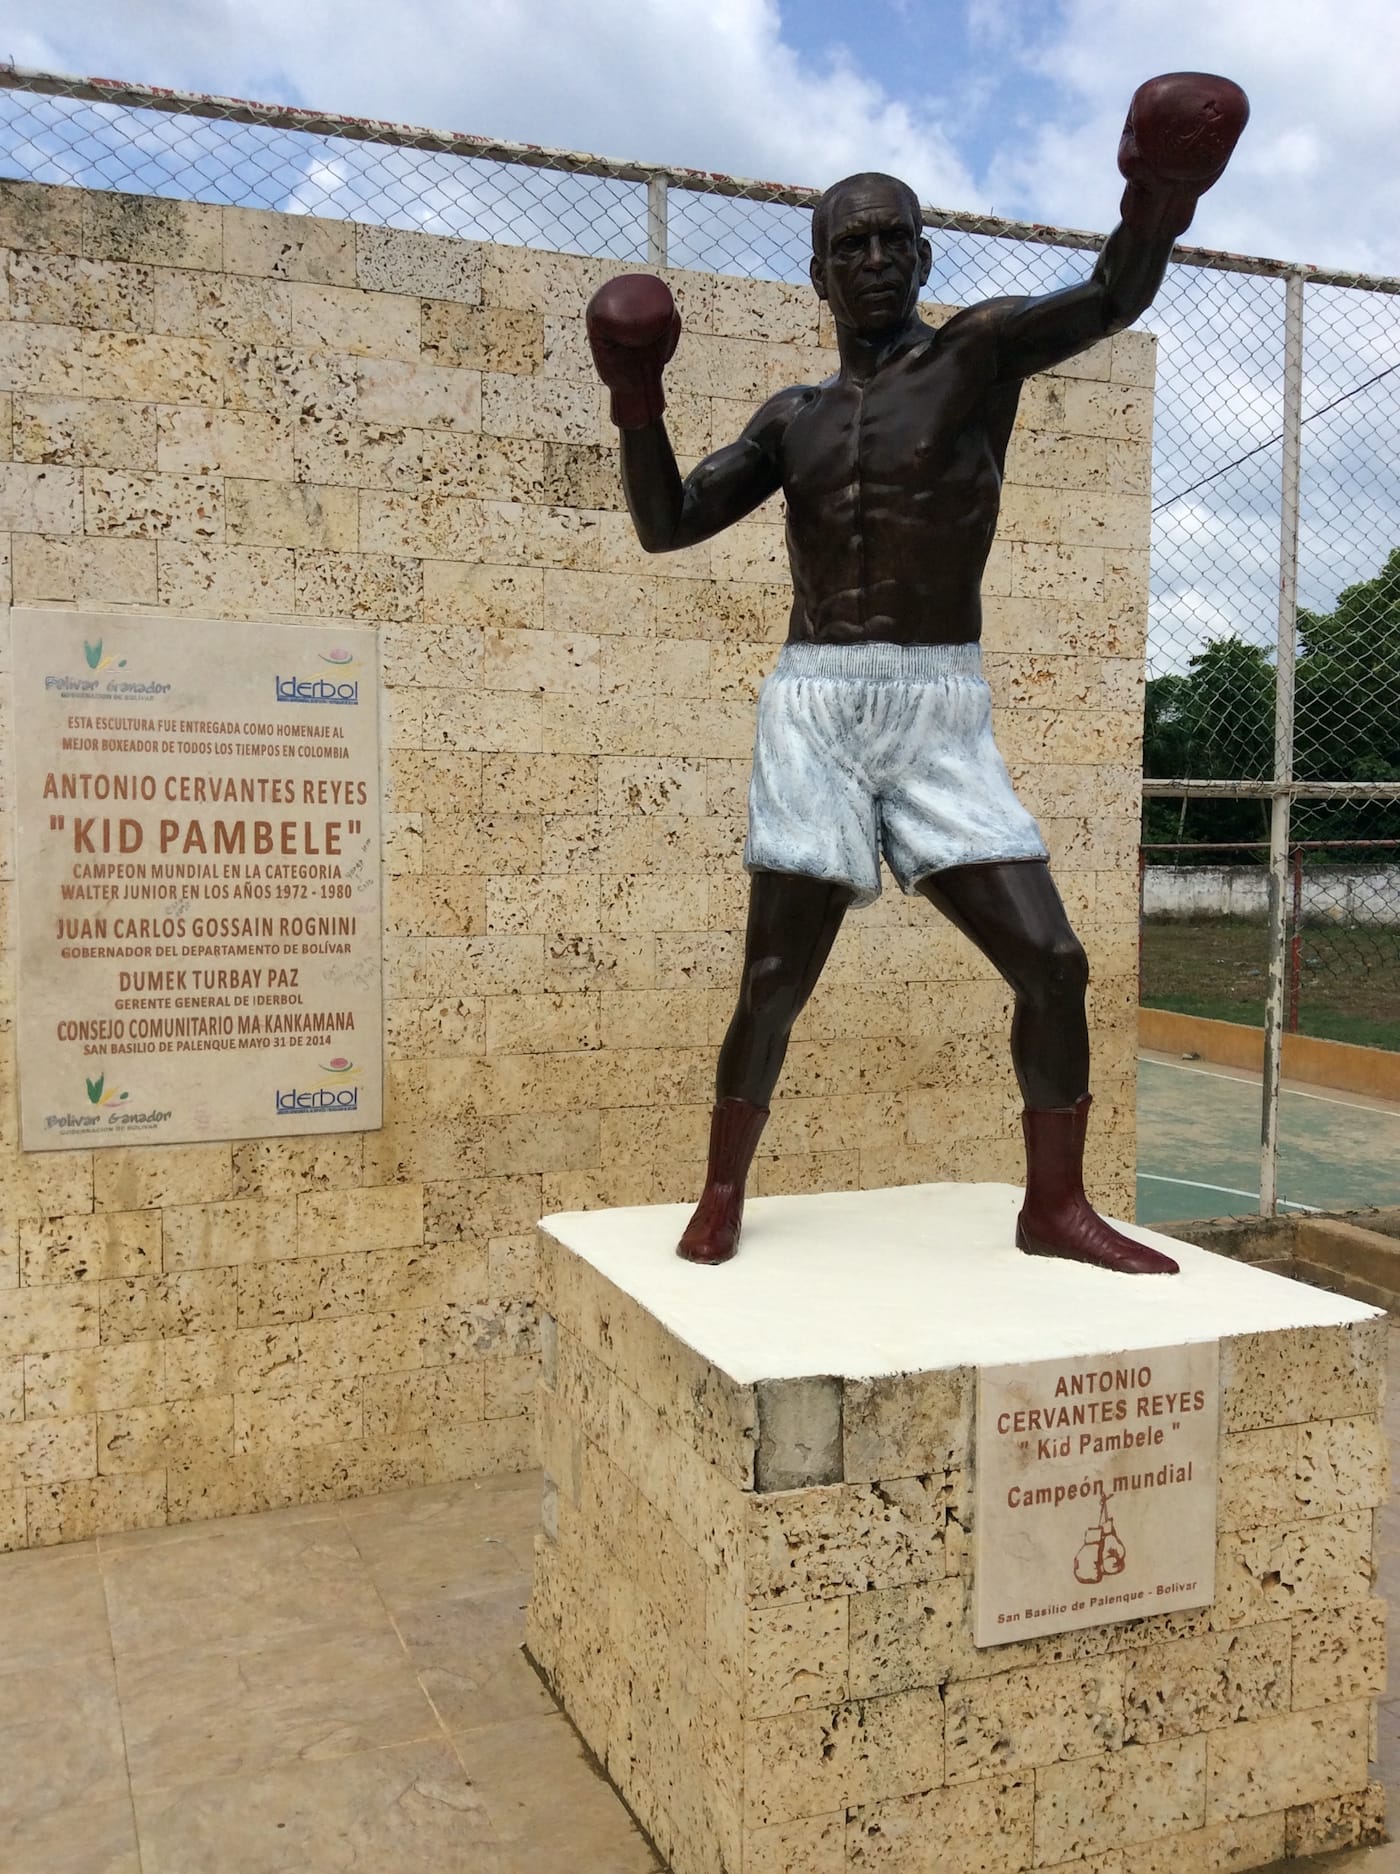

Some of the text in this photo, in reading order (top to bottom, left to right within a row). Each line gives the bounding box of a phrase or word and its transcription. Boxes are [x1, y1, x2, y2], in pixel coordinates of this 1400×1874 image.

[68, 716, 344, 739] ESTA ESCULTURA FUE ENTREGADA COMO HOMENAJE AL
[62, 737, 349, 759] MEJOR BOXEADOR DE TODOS LOS TIEMPOS EN COLOMBIA
[43, 772, 367, 806] ANTONIO CERVANTES REYES
[50, 814, 361, 855] "KID PAMBELE"
[72, 863, 341, 880] CAMPEON MUNDIAL EN LA CATEGORIA
[61, 884, 119, 900] WALTER
[123, 884, 177, 900] JUNIOR
[182, 884, 199, 899] EN
[204, 884, 229, 899] LOS
[233, 881, 271, 899] AÑOS
[276, 884, 308, 899] 1972
[320, 884, 352, 899] 1980
[56, 916, 356, 940] JUAN CARLOS GOSSAIN ROGNINI
[61, 940, 352, 959] GOBERNADOR DEL DEPARTAMENTO DE BOLÍVAR
[119, 970, 187, 992] DUMEK
[192, 968, 262, 990] TURBAY
[267, 968, 299, 988] PAZ
[114, 993, 304, 1010] GERENTE GENERAL DE IDERBOL
[57, 1011, 355, 1042] CONSEJO COMUNITARIO MA KANKAMANA
[83, 1034, 332, 1056] SAN BASILIO DE PALENQUE MAYO 31 DE 2014
[276, 1086, 358, 1110] Iderbol
[1055, 1366, 1152, 1398] ANTONIO
[996, 1389, 1205, 1435] CERVANTES REYES
[1007, 1461, 1194, 1509] Campeón mundial
[997, 1613, 1021, 1625] San
[1024, 1603, 1067, 1620] Basilio
[1071, 1599, 1085, 1612] de
[1090, 1590, 1144, 1608] Palenque
